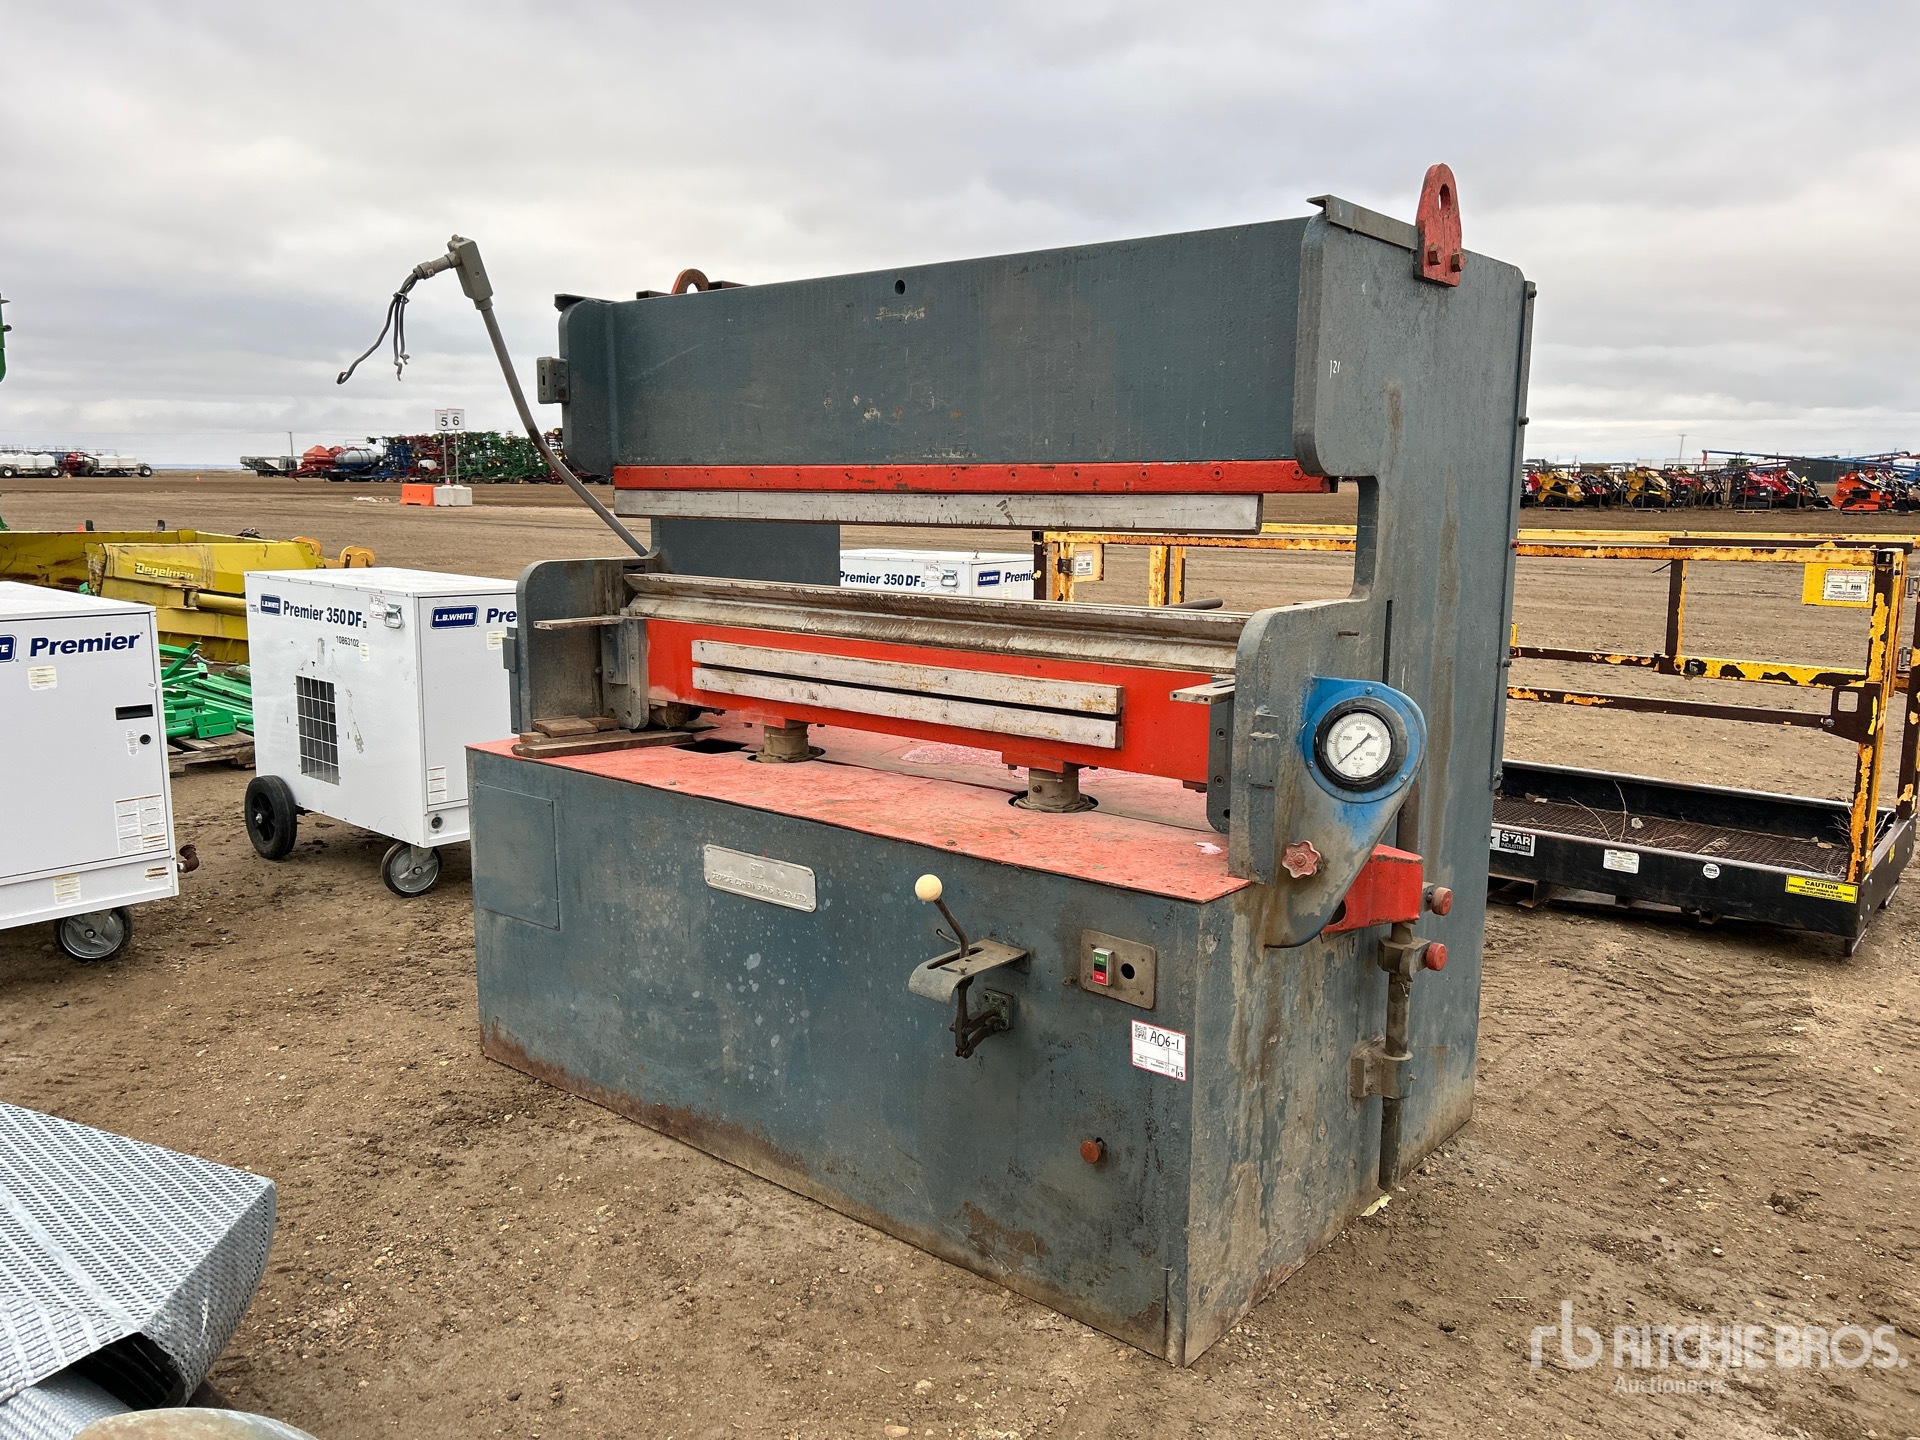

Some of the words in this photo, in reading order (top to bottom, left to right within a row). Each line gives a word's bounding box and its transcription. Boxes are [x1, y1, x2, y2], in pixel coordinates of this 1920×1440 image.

[441, 416, 448, 427] 5
[452, 416, 460, 426] 6
[134, 562, 194, 579] Degelman
[283, 600, 324, 621] Premier
[435, 612, 475, 622] L.B.WHITE
[30, 632, 140, 657] Premier
[1501, 833, 1531, 846] STAR
[1501, 842, 1530, 851] INDUSTRIES
[1805, 881, 1839, 890] CAUTION
